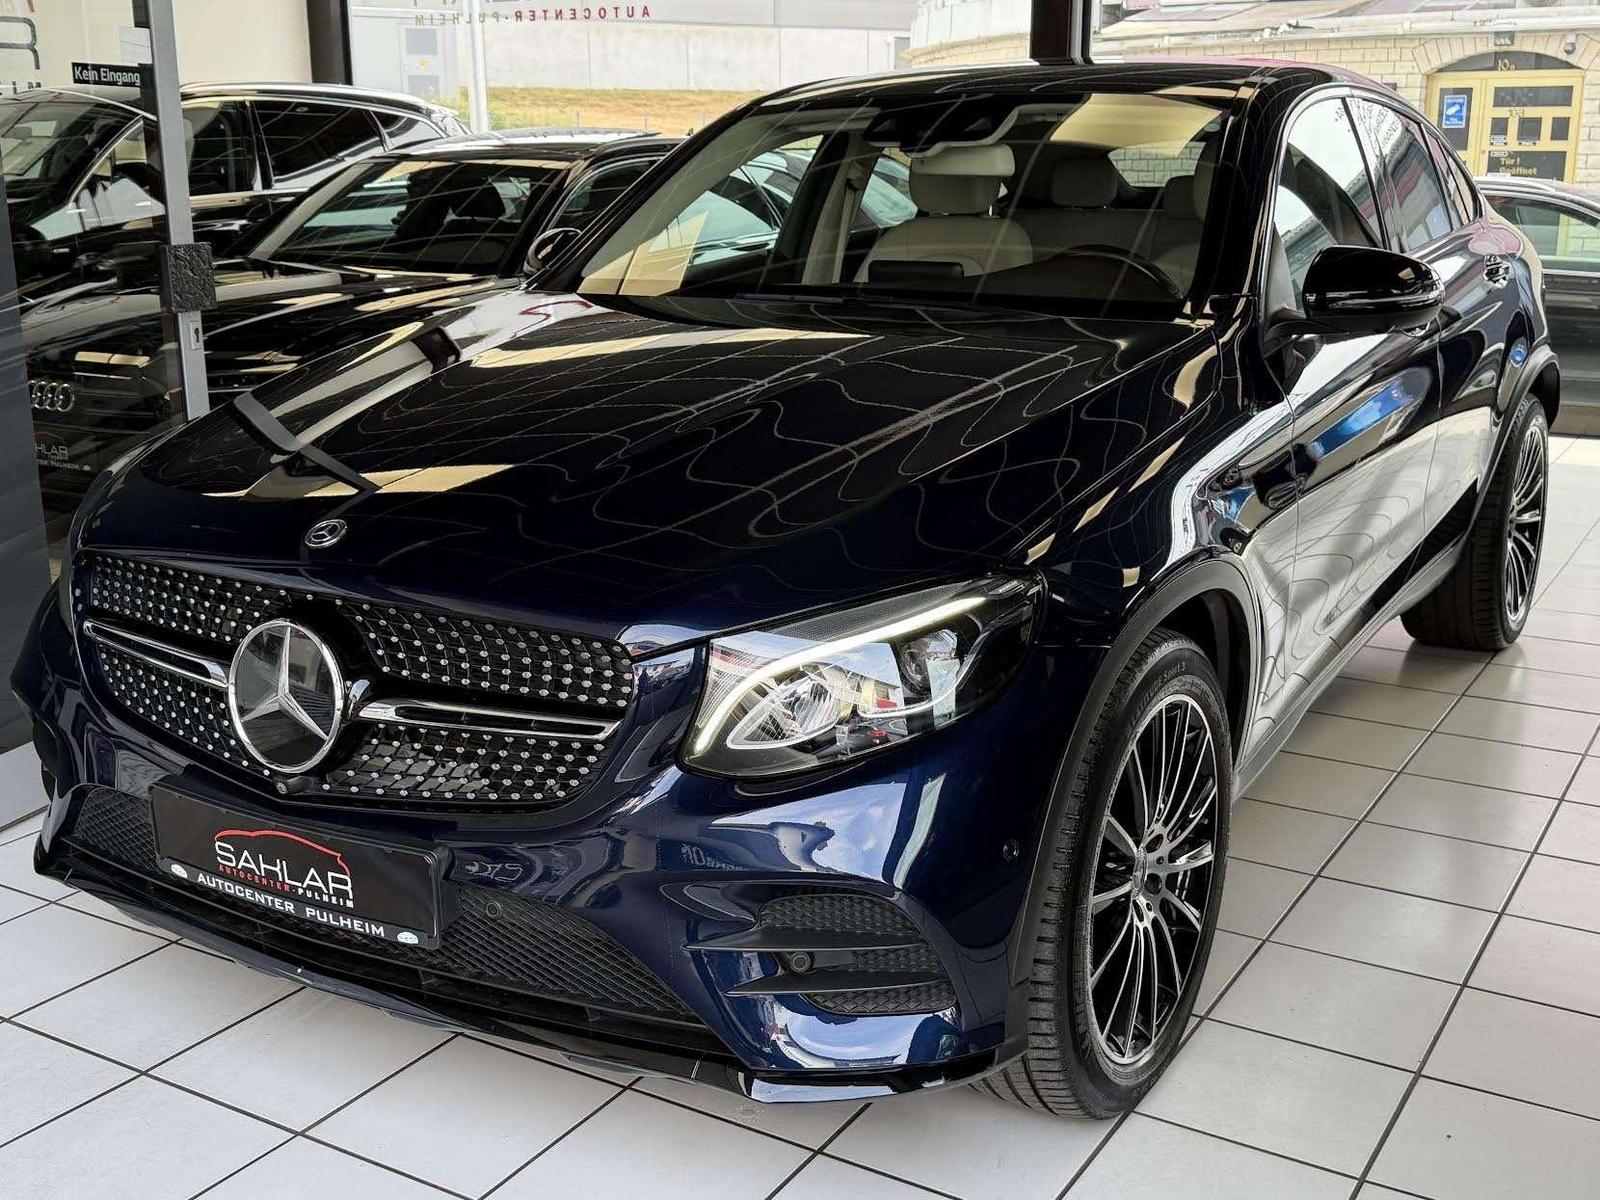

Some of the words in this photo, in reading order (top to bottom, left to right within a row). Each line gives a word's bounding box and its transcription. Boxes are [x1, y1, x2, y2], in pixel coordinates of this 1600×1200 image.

[74, 65, 99, 81] Kein
[100, 67, 140, 86] Eingang
[35, 442, 68, 460] HLAR
[214, 841, 354, 900] SAHLAR
[197, 873, 296, 914] AUTOCENTER
[305, 907, 386, 938] PULHEIM
